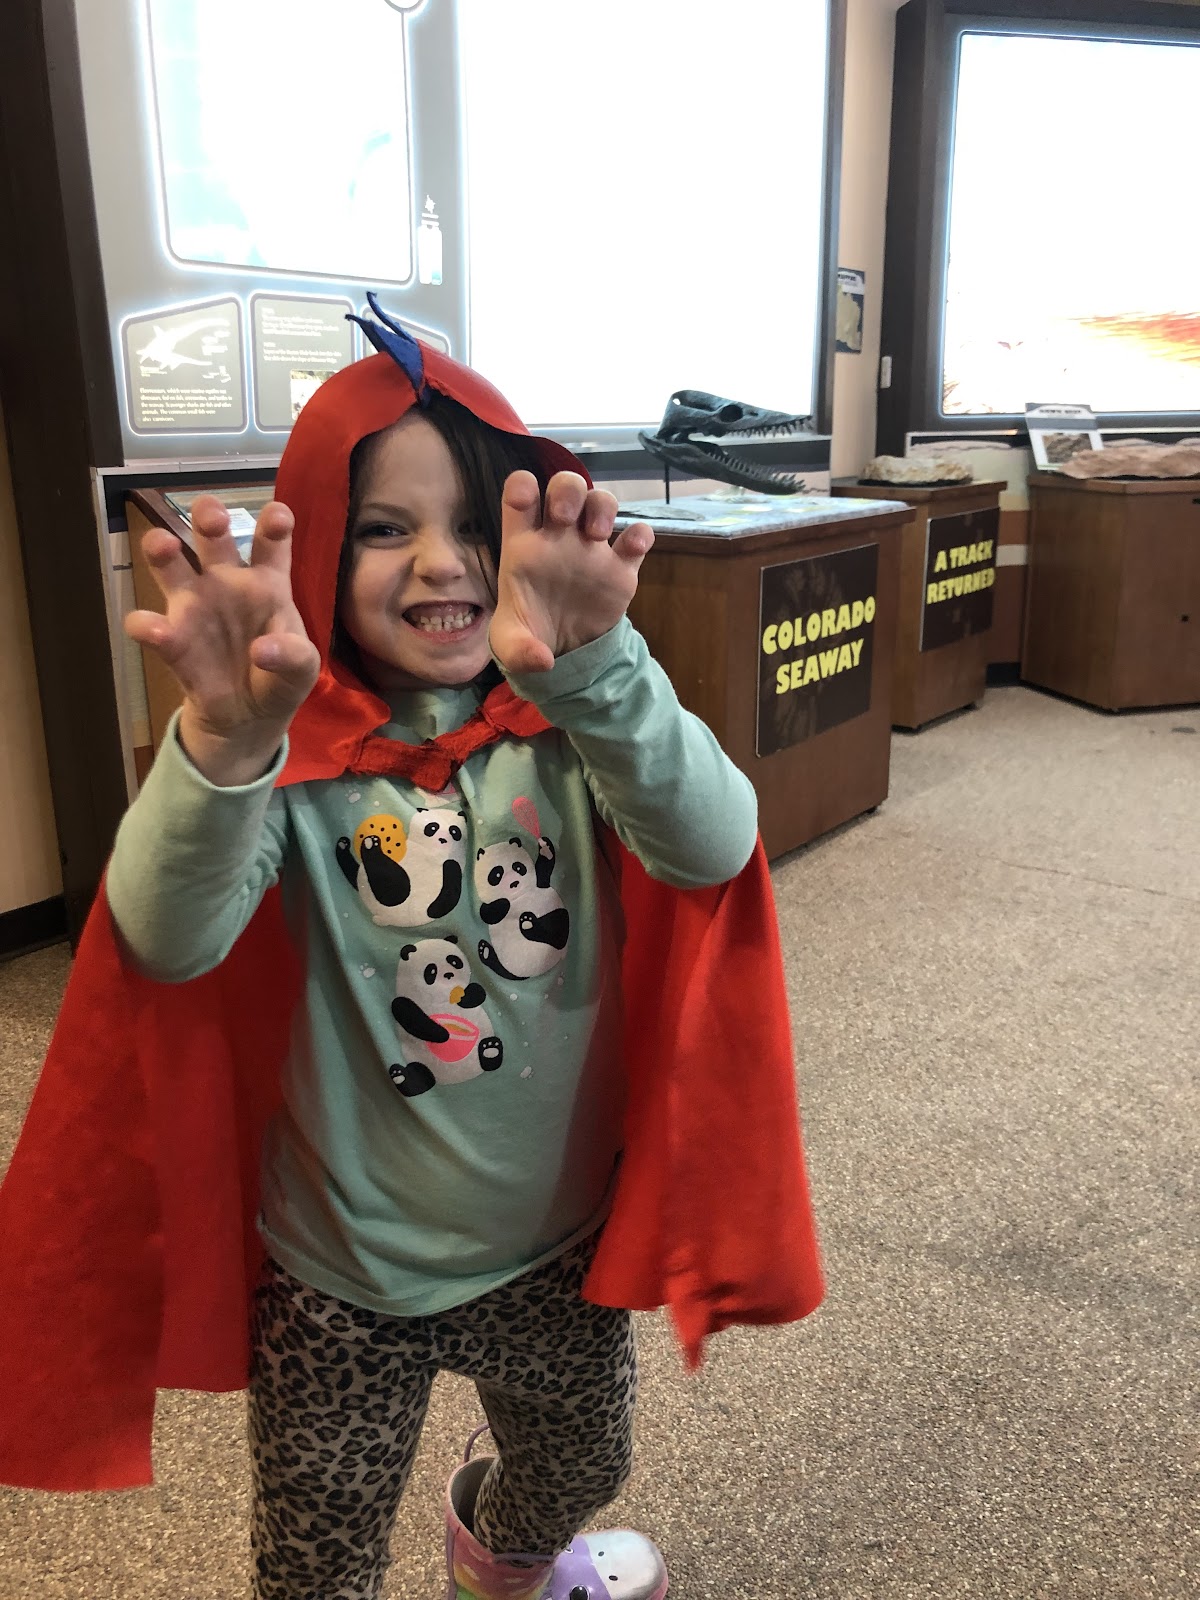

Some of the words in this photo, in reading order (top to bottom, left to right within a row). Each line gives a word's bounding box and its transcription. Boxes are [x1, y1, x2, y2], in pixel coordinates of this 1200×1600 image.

[934, 550, 947, 573] A
[949, 540, 993, 569] TRACK
[927, 568, 995, 605] RETURNED
[762, 596, 876, 655] COLORADO
[776, 638, 865, 695] SEAWAY
